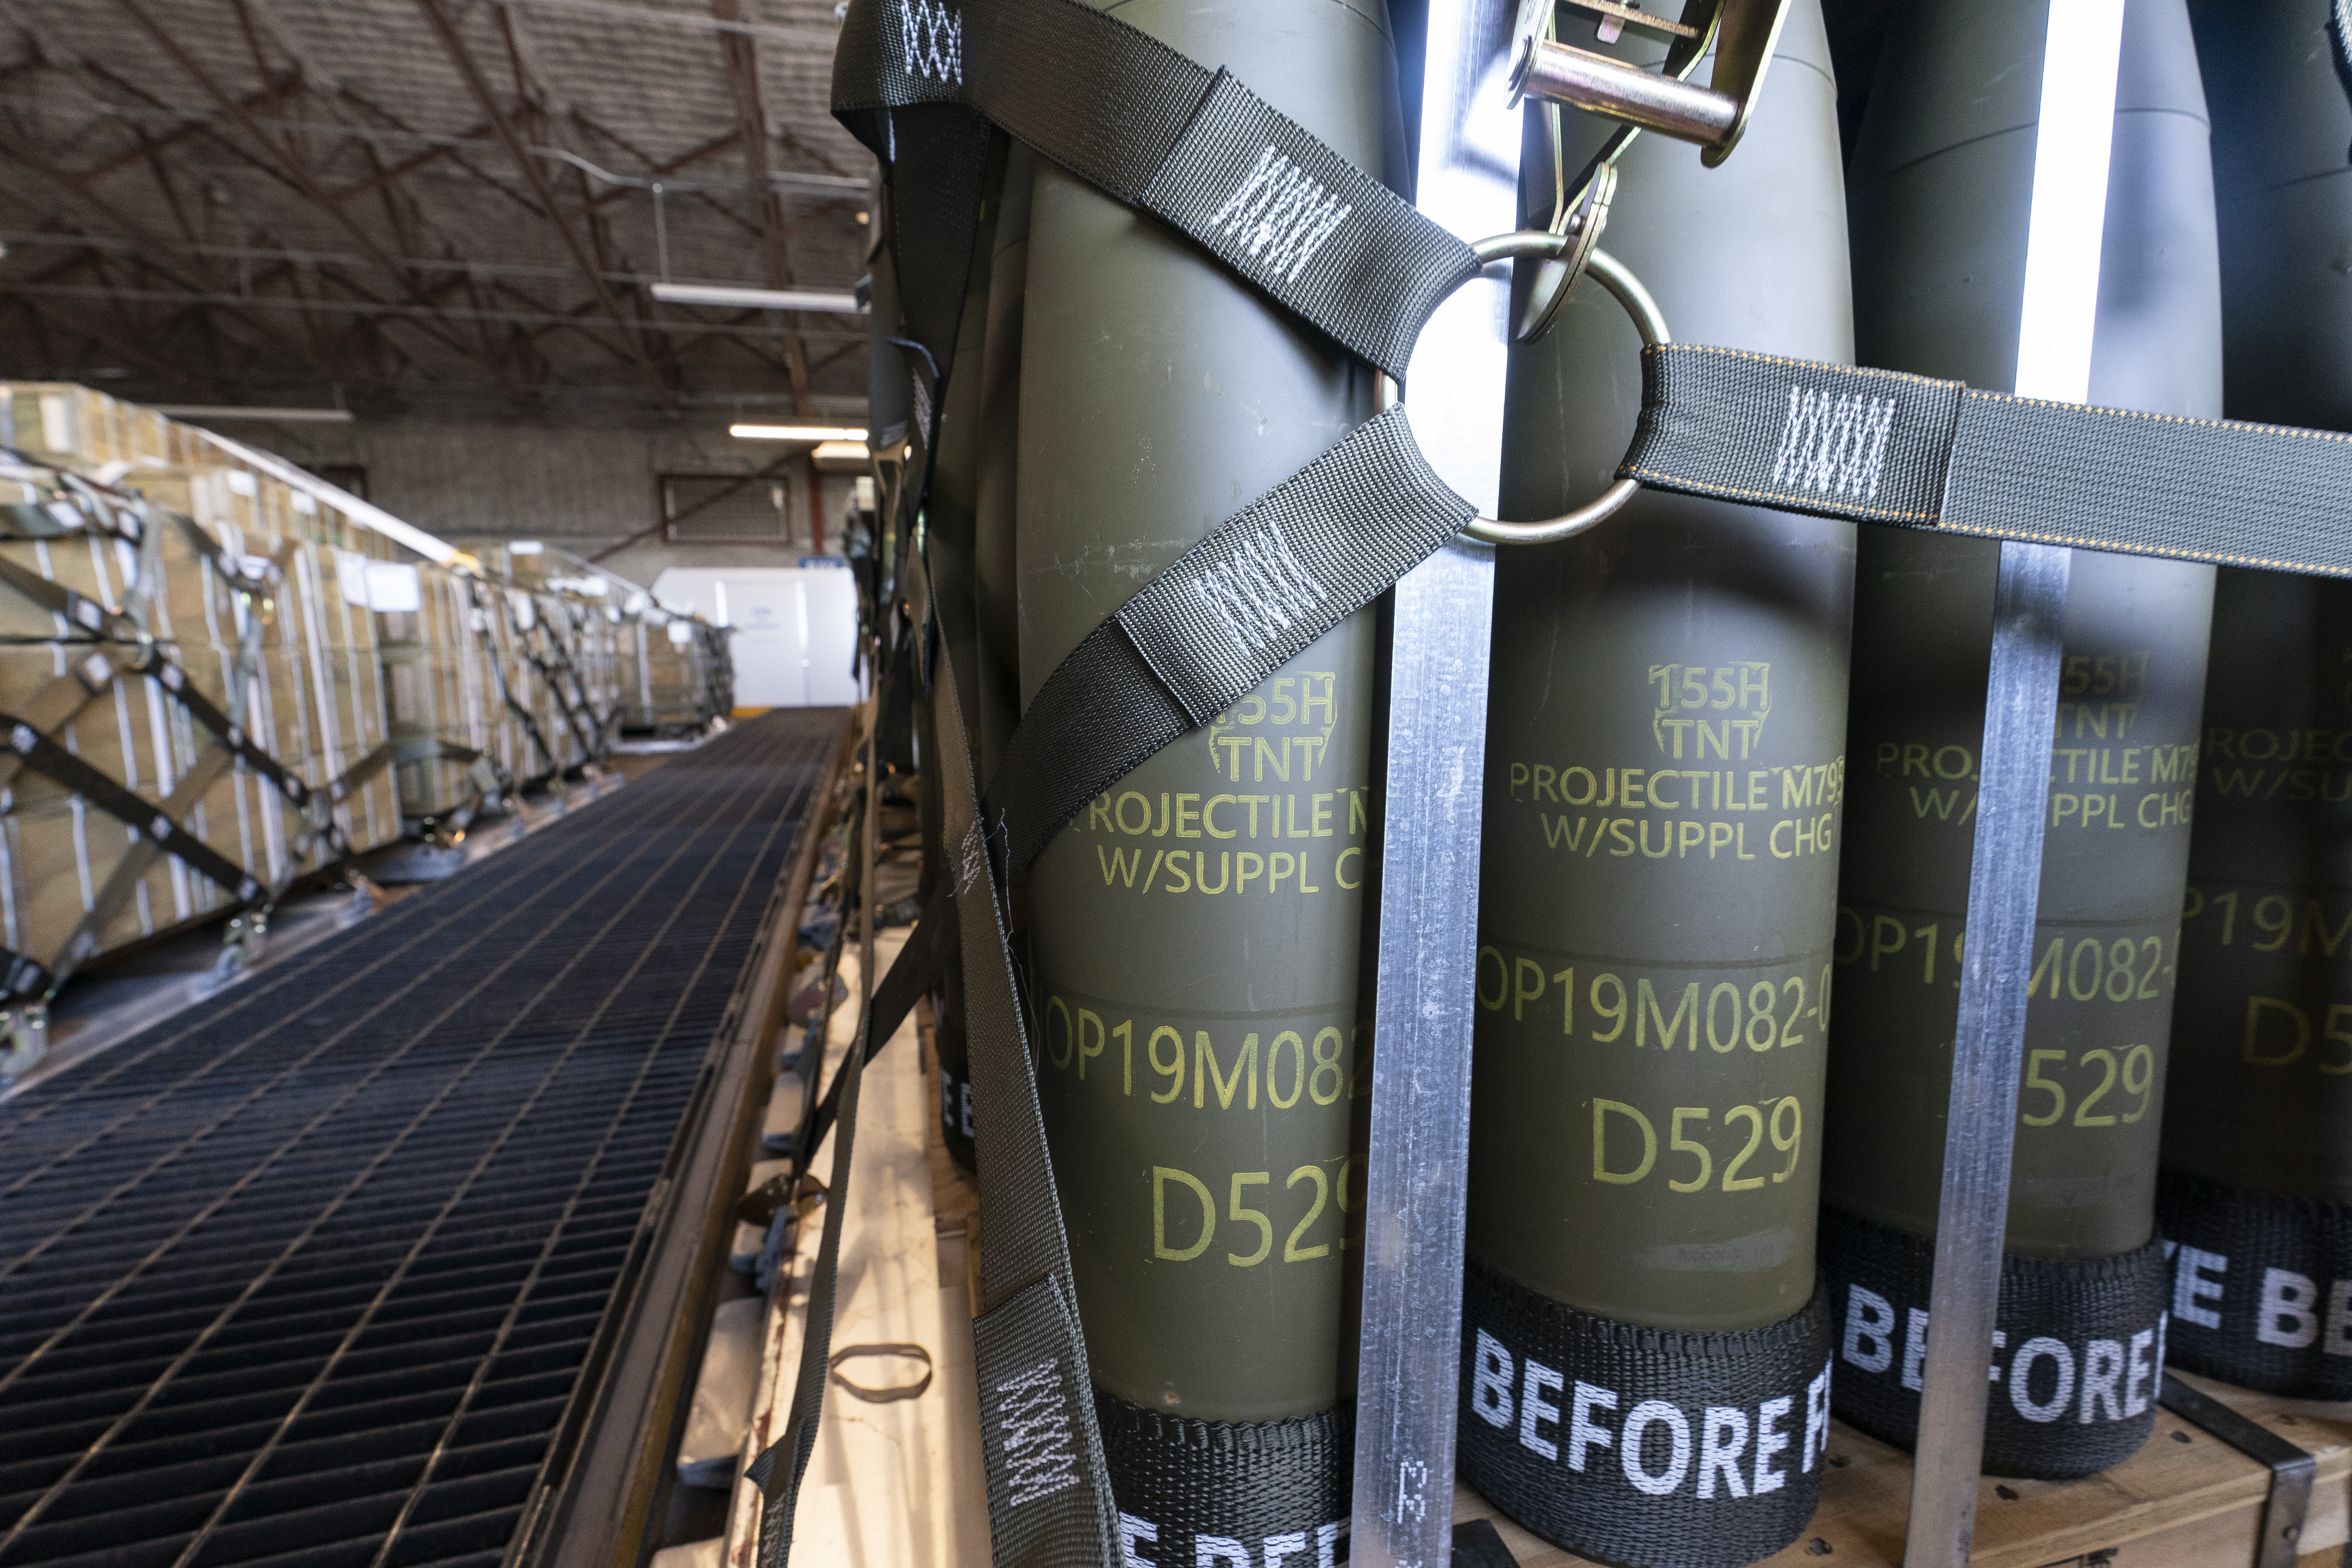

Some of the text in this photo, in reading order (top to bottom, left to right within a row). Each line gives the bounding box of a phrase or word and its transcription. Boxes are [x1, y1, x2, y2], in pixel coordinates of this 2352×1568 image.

[1218, 737, 1323, 781] TNT
[1661, 719, 1759, 760] TNT
[1510, 762, 1769, 811] PROJECTILE
[2138, 789, 2192, 828] CHG
[1090, 788, 1334, 839] ROJECTILE
[1540, 813, 1832, 860] W/SUPPL CHG
[1098, 845, 1319, 894] W/SUPPL
[2022, 1044, 2154, 1127] 529
[1593, 1095, 1802, 1193] D529
[1472, 1327, 1793, 1499] BEFORE
